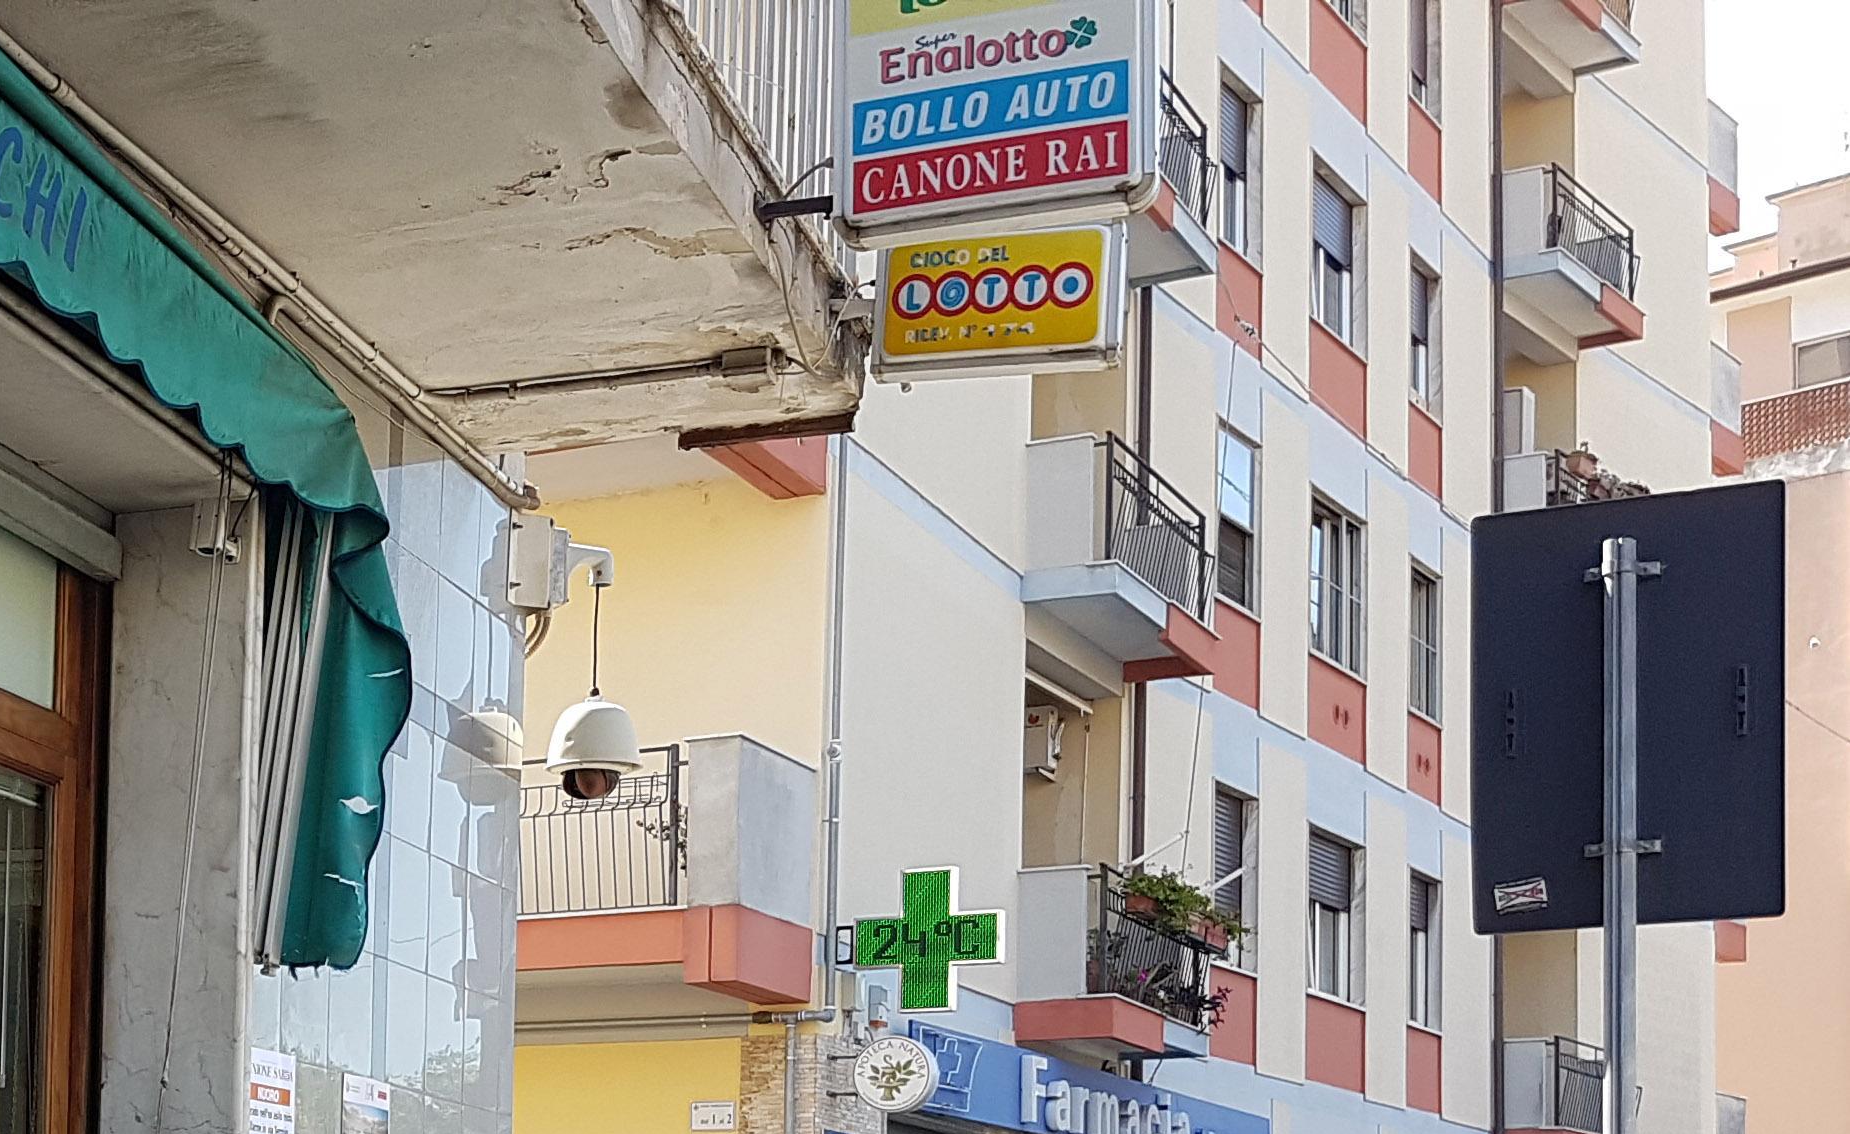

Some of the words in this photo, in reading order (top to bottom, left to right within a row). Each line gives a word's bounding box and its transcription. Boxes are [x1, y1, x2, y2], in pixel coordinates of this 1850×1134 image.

[881, 28, 1068, 85] Enalotto
[915, 33, 957, 51] Super
[861, 91, 989, 146] BOLLO
[1004, 70, 1117, 121] AUTO
[861, 144, 1028, 204] CANONE
[1044, 131, 1120, 177] RAI
[898, 268, 1086, 315] LOTTO
[873, 920, 979, 959] 24°C
[857, 1040, 894, 1078] APOTECA
[898, 1042, 926, 1079] NATURA
